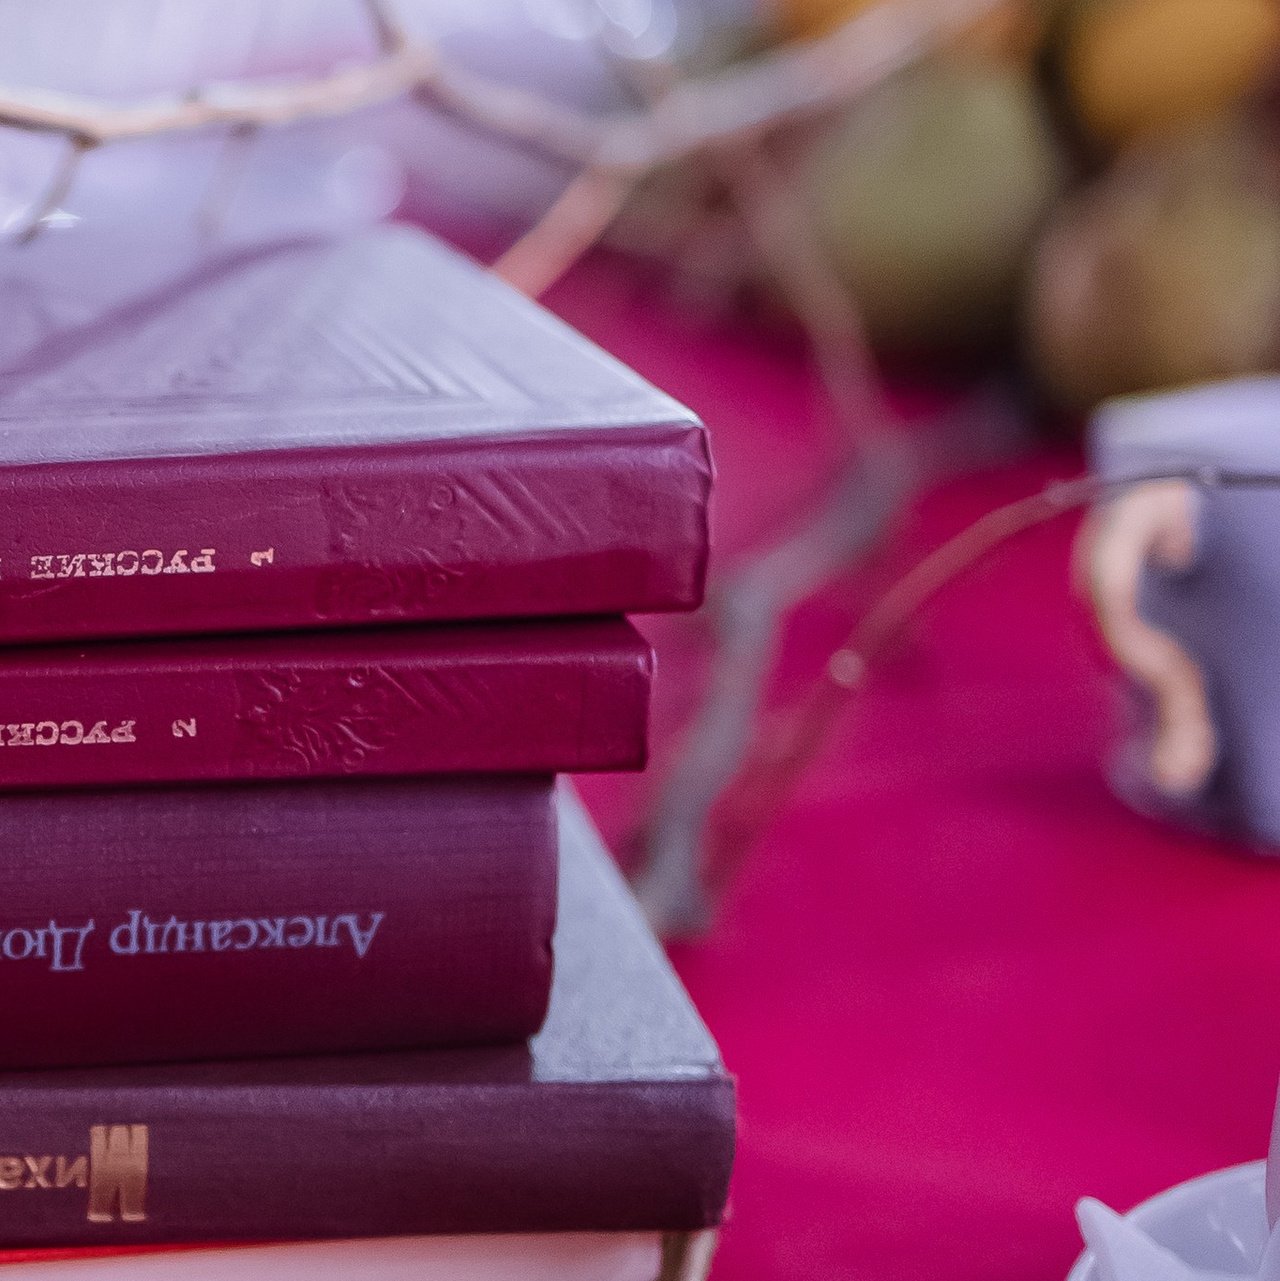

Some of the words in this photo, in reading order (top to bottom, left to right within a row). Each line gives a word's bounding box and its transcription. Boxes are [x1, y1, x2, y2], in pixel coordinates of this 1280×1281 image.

[30, 548, 216, 580] РУССКИЕ
[172, 718, 197, 738] 2
[109, 910, 384, 959] Александр
